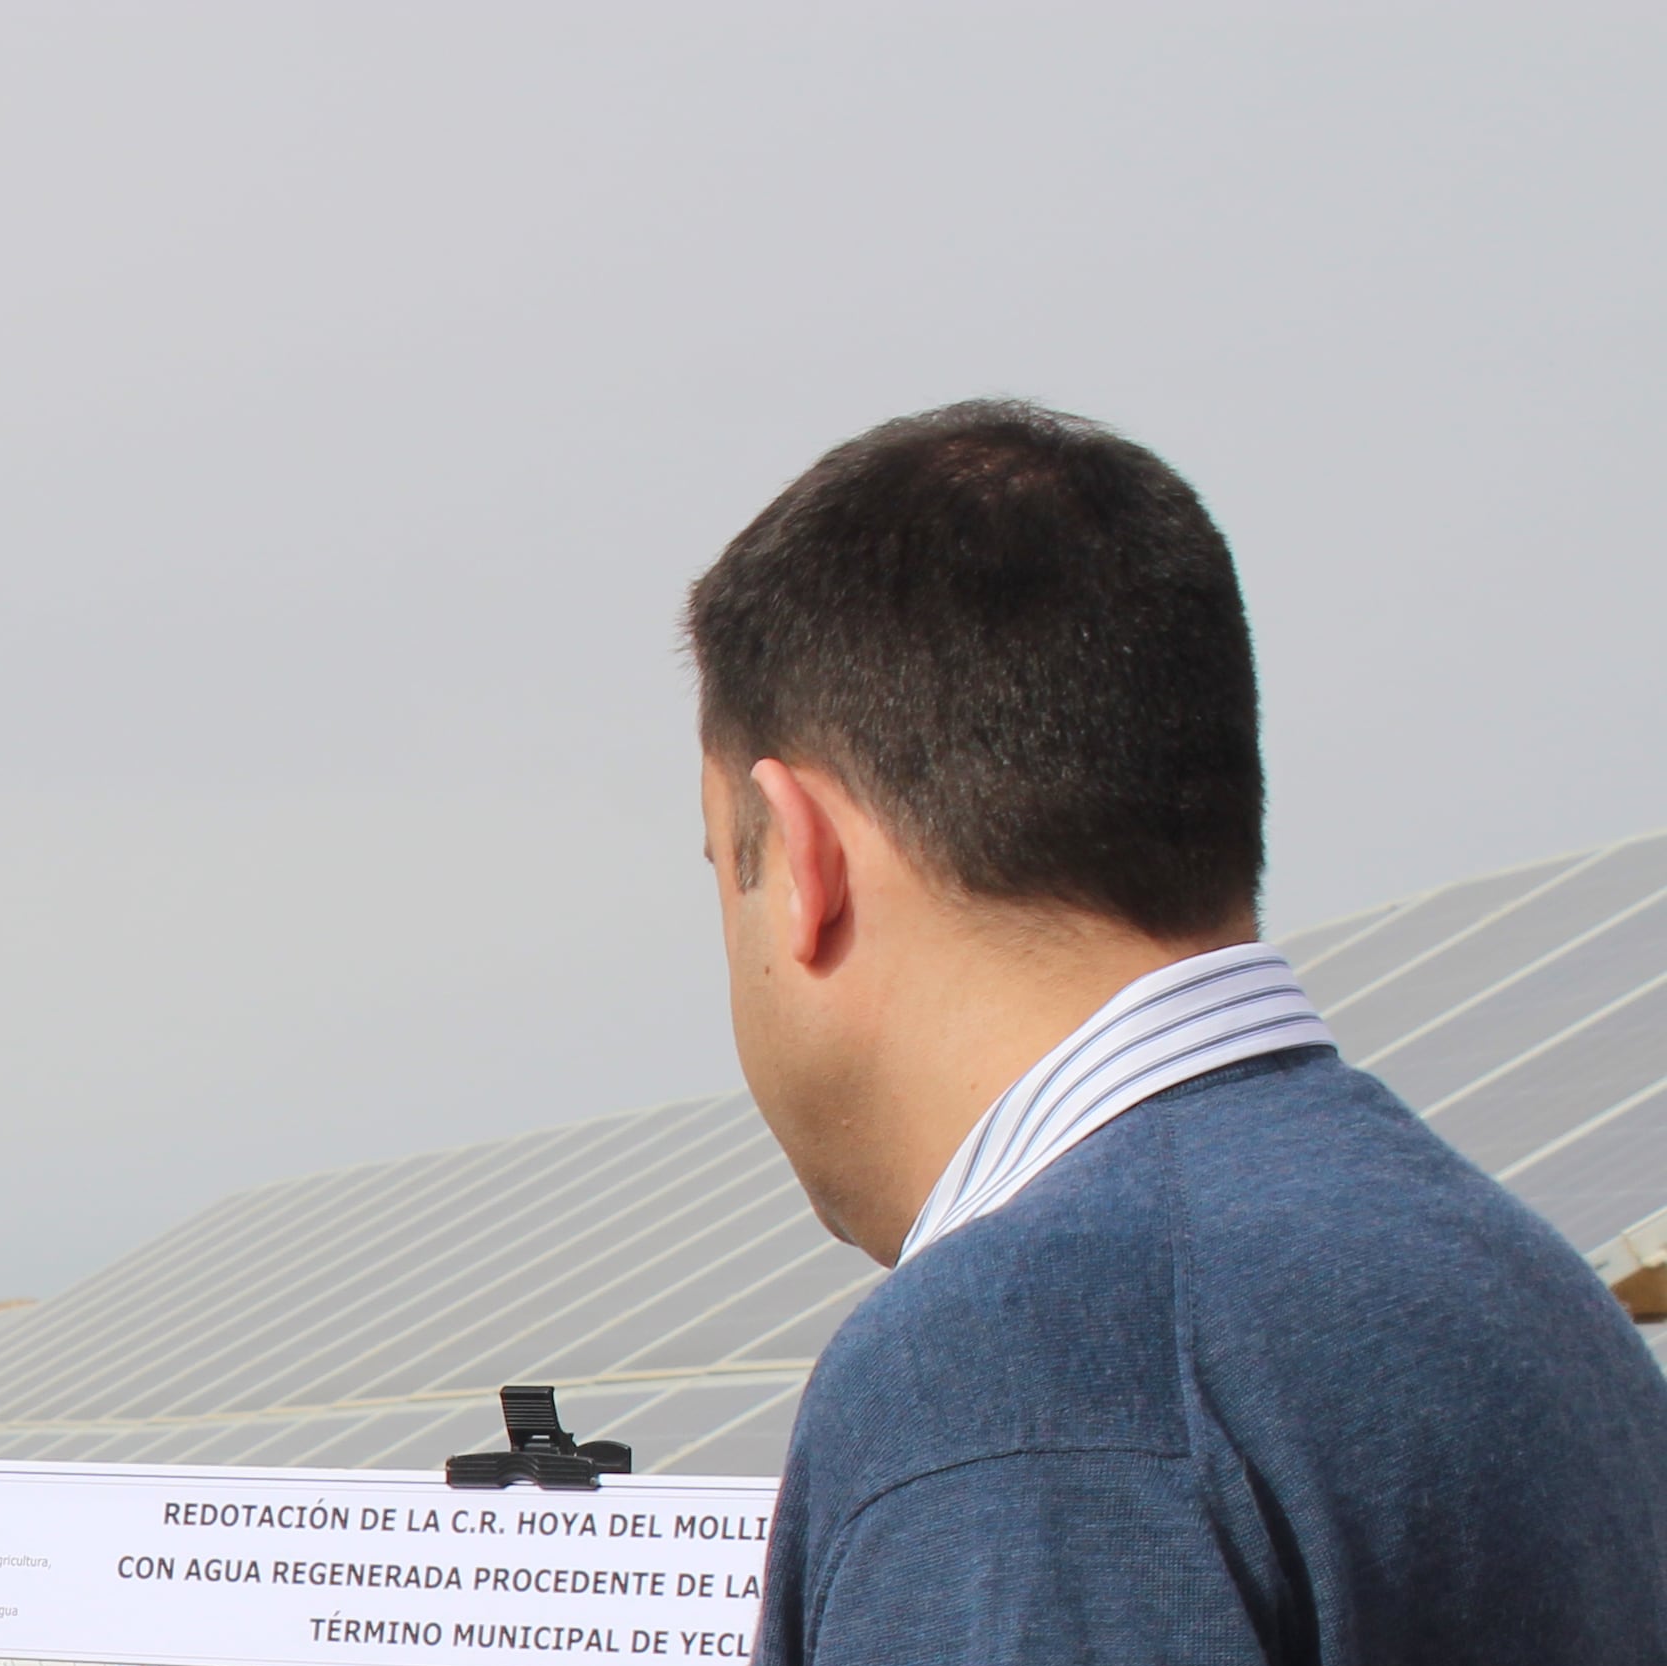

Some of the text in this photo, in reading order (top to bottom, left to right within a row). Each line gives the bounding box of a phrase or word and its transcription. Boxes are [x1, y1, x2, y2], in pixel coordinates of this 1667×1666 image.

[163, 1498, 349, 1530] REDOTACIÓN
[360, 1508, 396, 1531] DE
[407, 1509, 441, 1533] LA
[450, 1510, 505, 1535] C.R.
[517, 1511, 597, 1537] HOYA
[608, 1514, 663, 1539] DEL
[117, 1556, 761, 1600] CON AGUA REGENERADA PROCEDENTE DE LA
[310, 1611, 443, 1646] TÉRMINO
[453, 1623, 620, 1653] MUNICIPAL
[631, 1630, 668, 1654] DE
